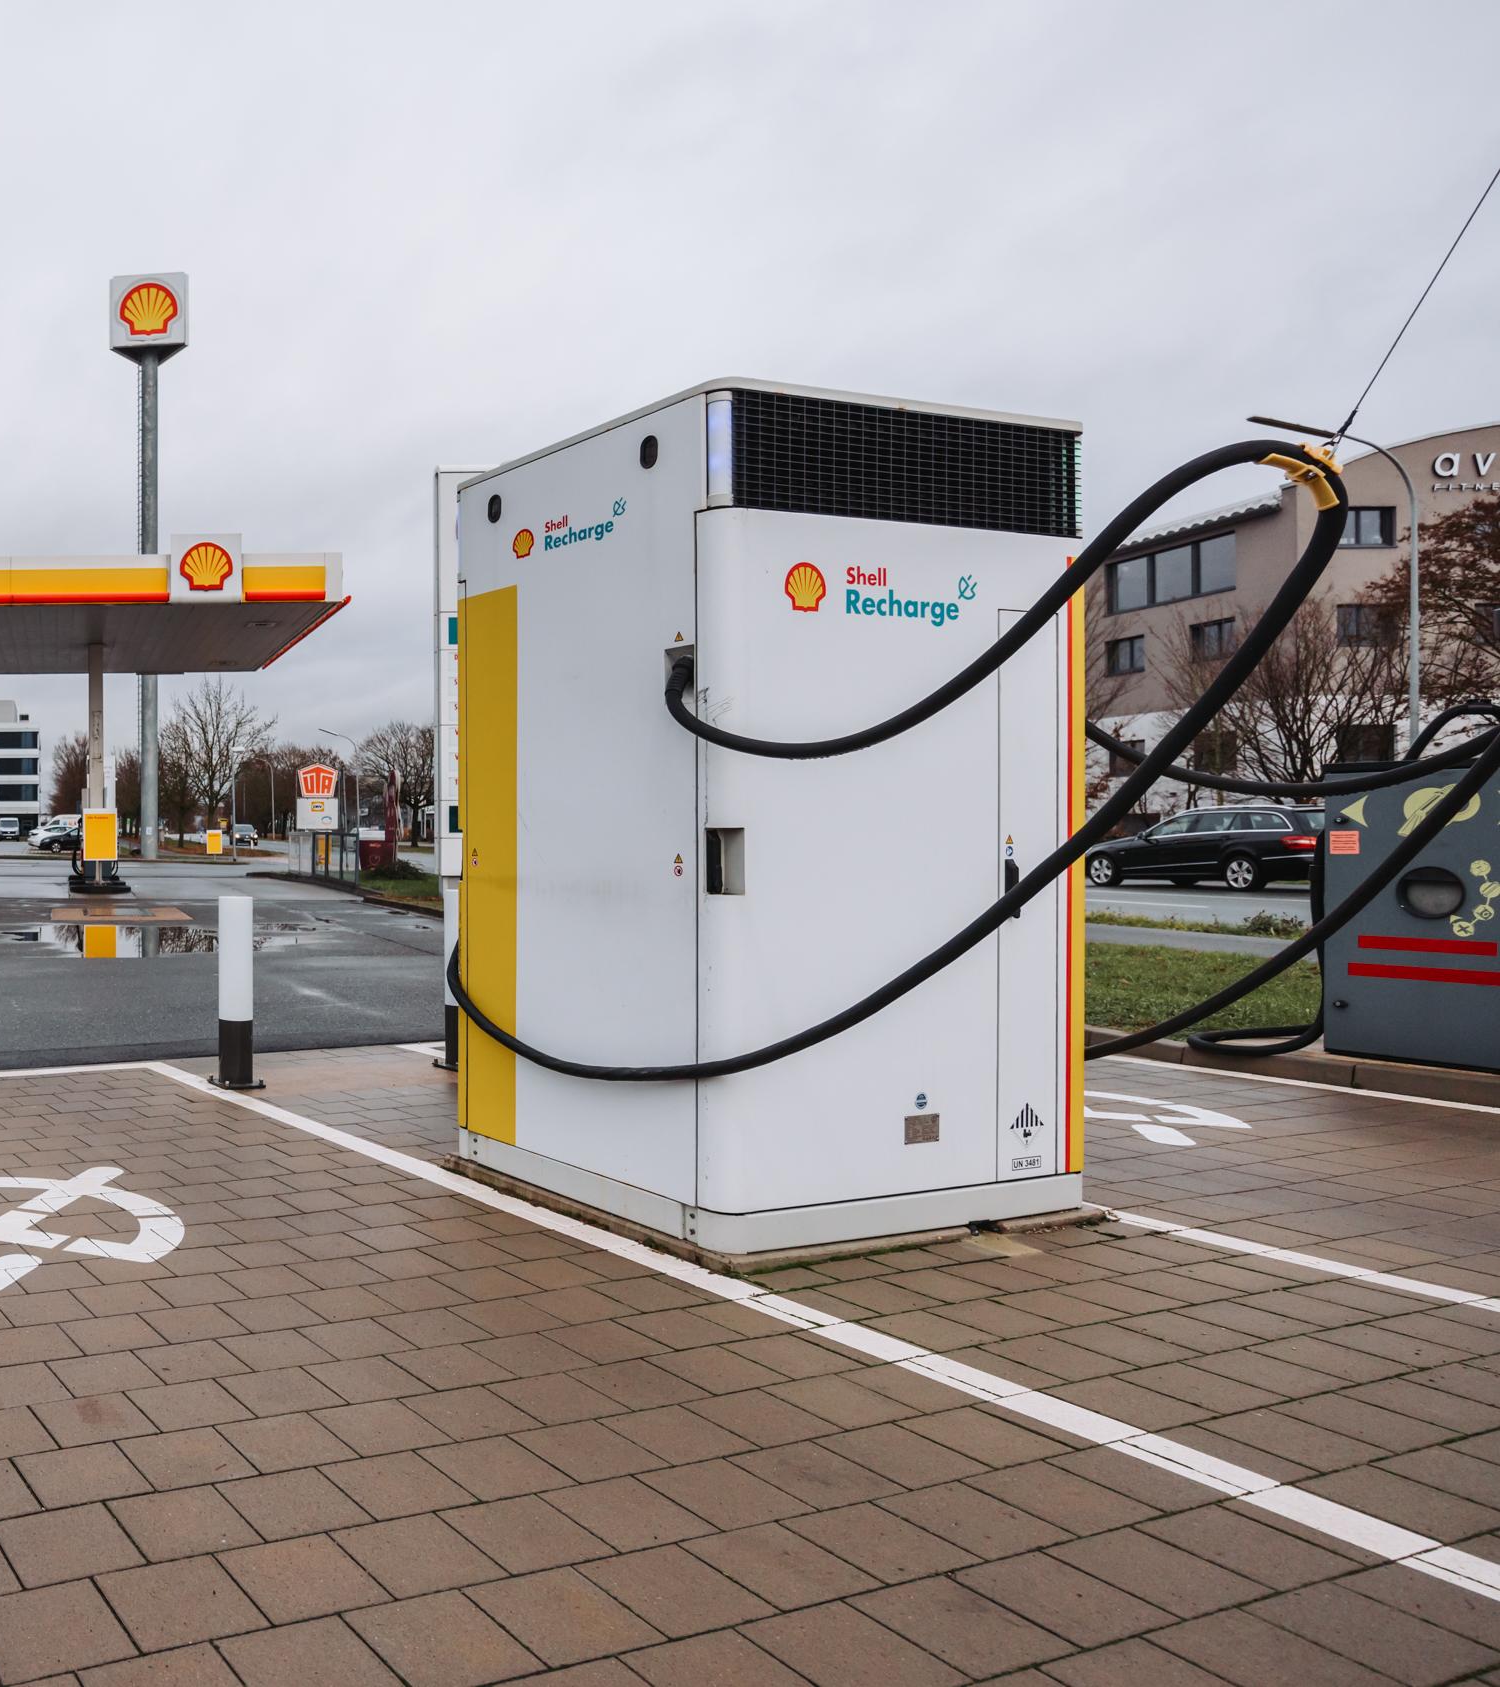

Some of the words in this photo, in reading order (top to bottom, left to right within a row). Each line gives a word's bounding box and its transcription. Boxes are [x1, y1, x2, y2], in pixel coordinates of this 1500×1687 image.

[544, 520, 614, 551] Recharge
[545, 514, 568, 533] Shell
[846, 565, 887, 587] Shell
[845, 588, 959, 627] Recharge
[302, 767, 334, 795] UTA
[1013, 1160, 1024, 1169] UN
[1024, 1158, 1039, 1167] 3481
